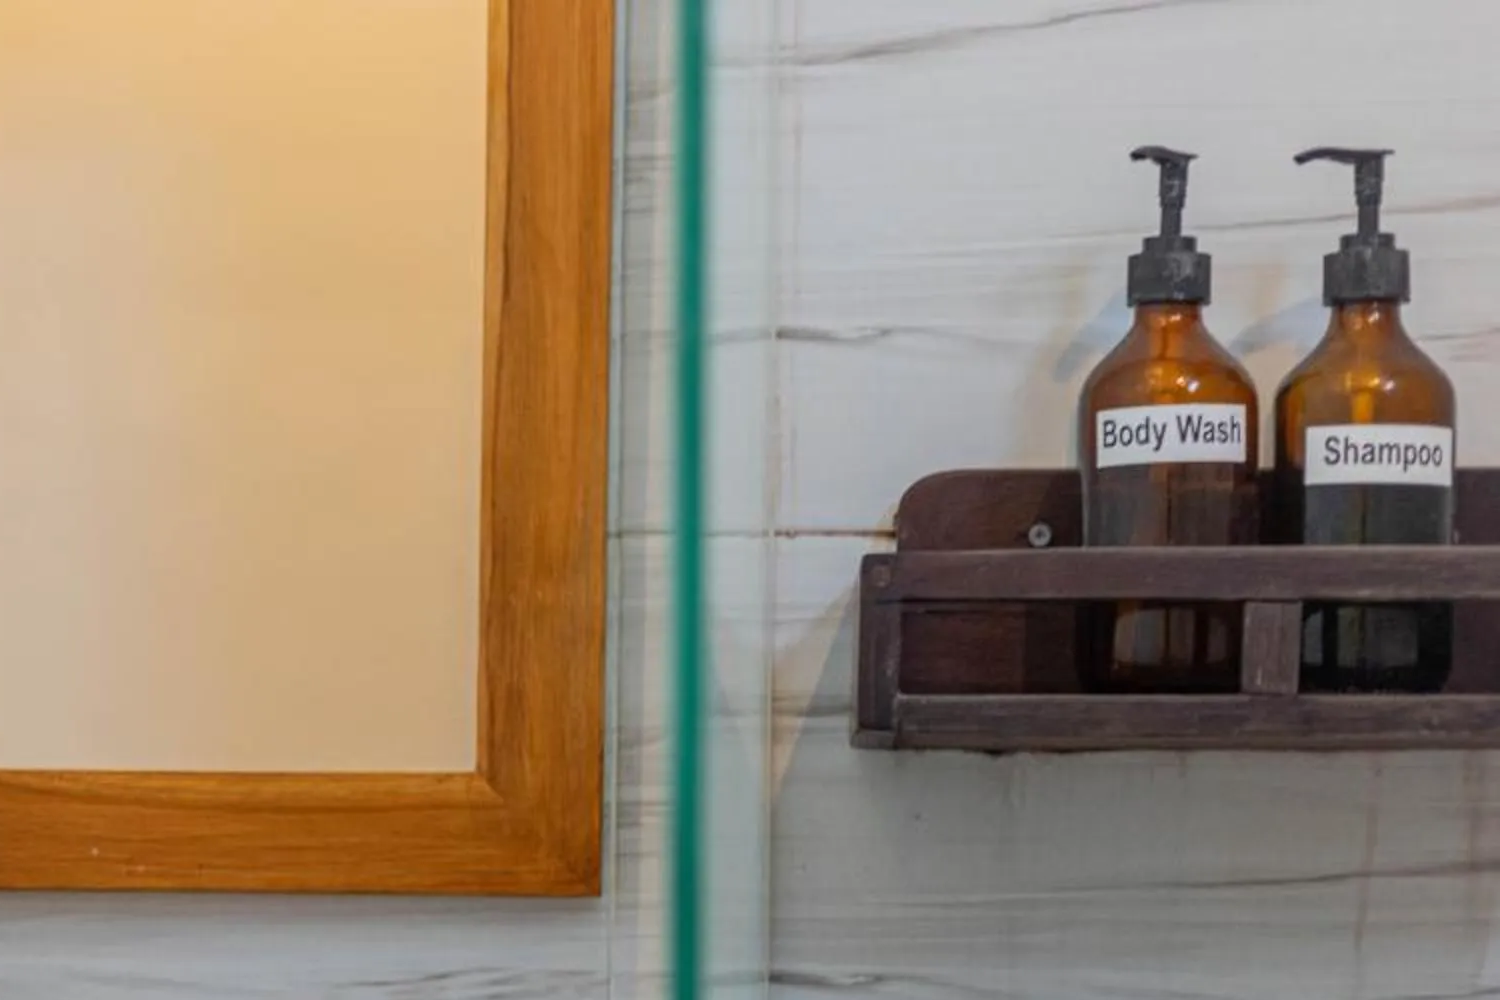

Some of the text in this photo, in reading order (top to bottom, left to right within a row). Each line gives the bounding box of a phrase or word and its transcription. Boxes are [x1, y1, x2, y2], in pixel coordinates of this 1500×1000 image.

[1102, 413, 1241, 452] Body Wash
[1323, 435, 1444, 473] Shampoo
